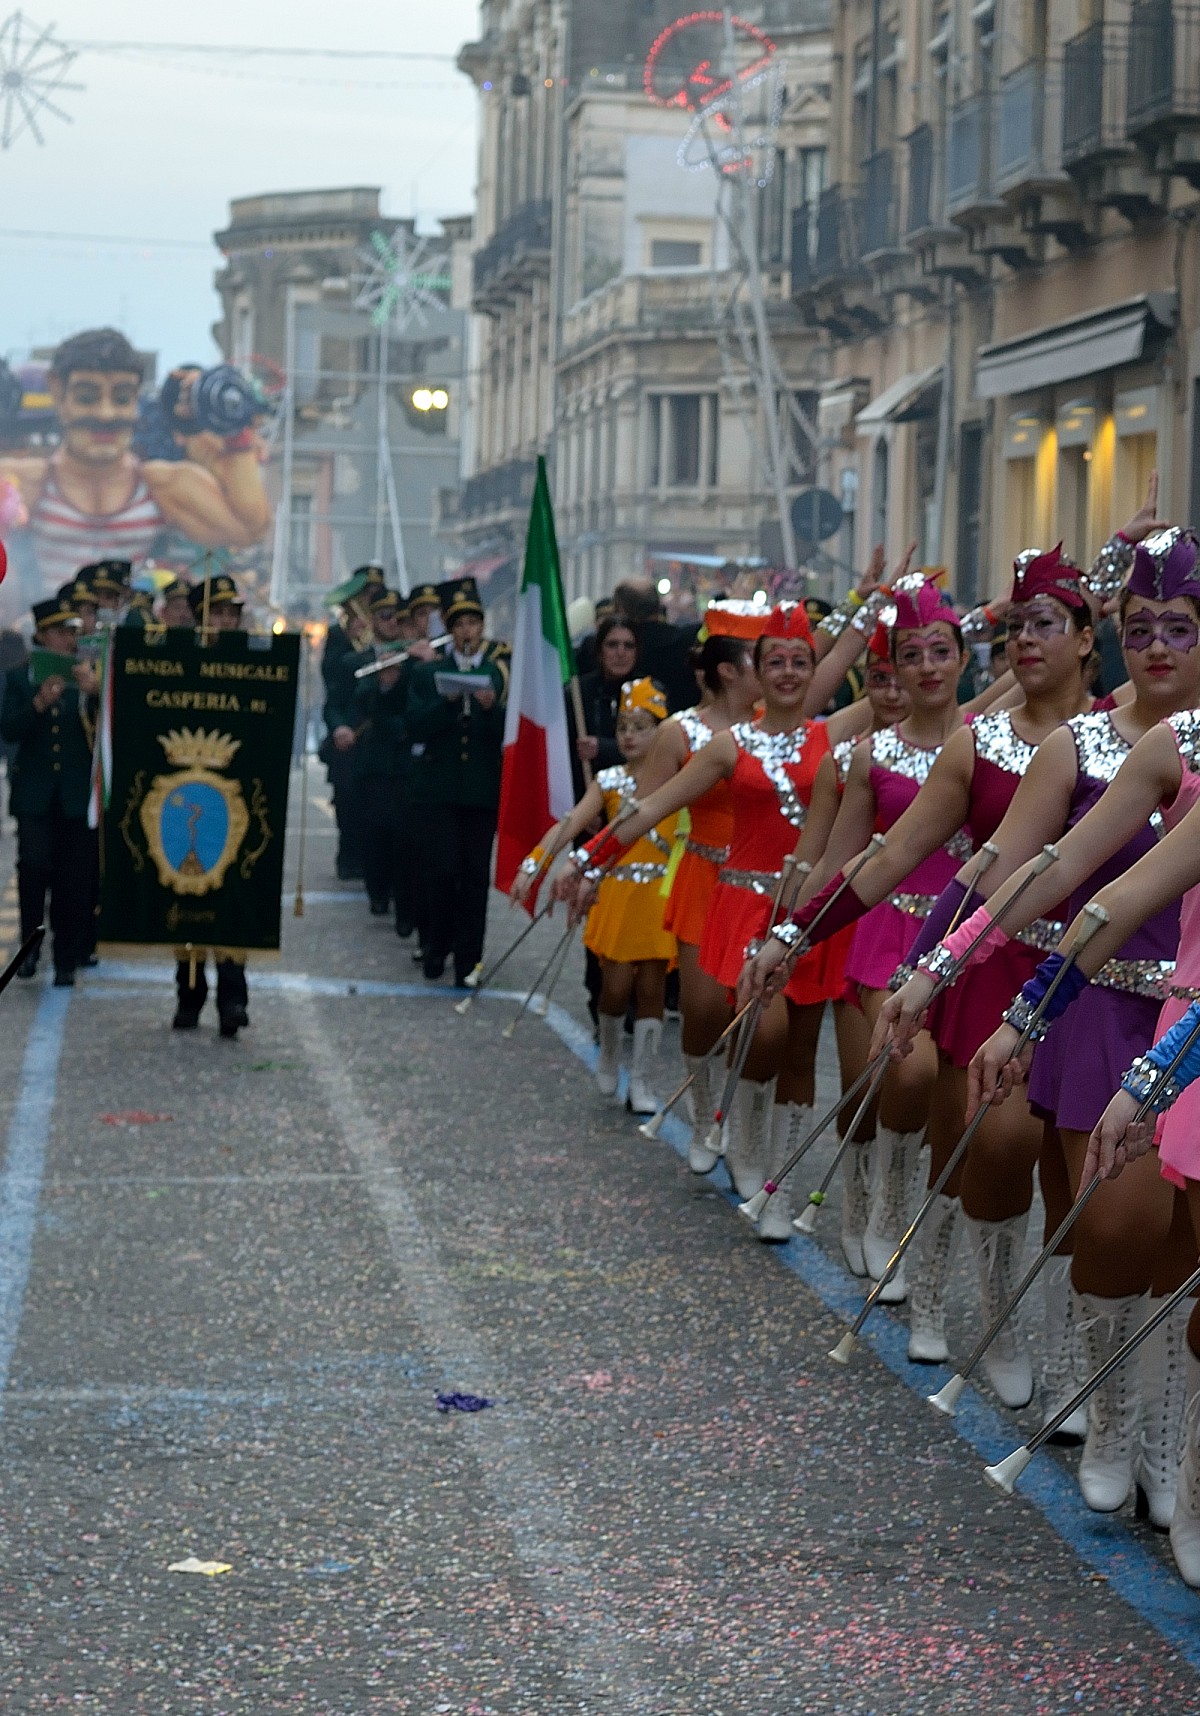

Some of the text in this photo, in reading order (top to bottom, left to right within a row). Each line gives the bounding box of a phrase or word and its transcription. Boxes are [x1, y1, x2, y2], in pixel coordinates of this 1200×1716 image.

[125, 657, 289, 682] BANDA MUSICALE
[145, 688, 240, 712] CASPERIA
